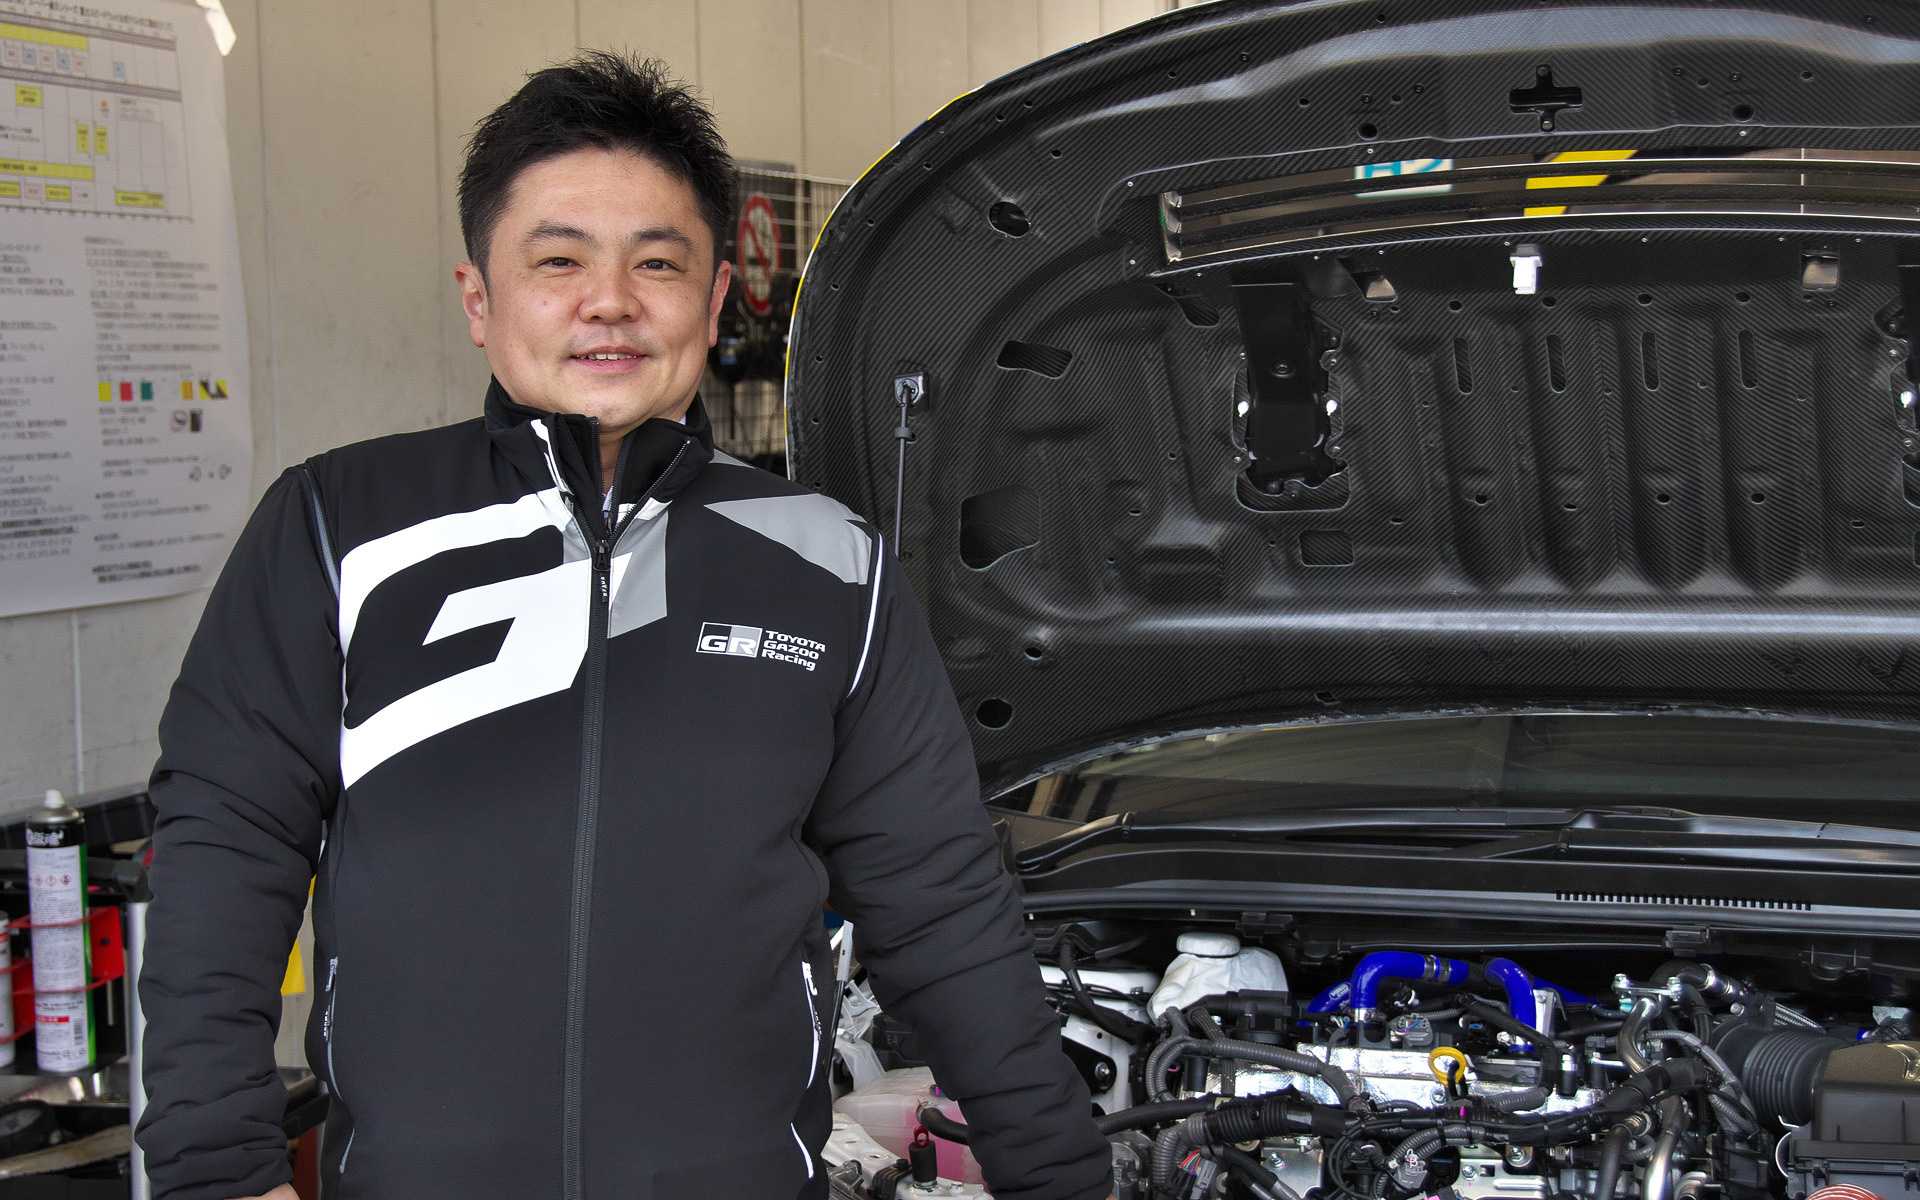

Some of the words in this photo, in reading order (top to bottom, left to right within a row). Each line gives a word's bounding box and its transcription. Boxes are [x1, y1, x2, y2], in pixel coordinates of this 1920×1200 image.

[700, 634, 757, 656] GR
[763, 639, 820, 660] GAZOO
[765, 629, 826, 653] TOYOTA
[761, 648, 816, 672] Racing
